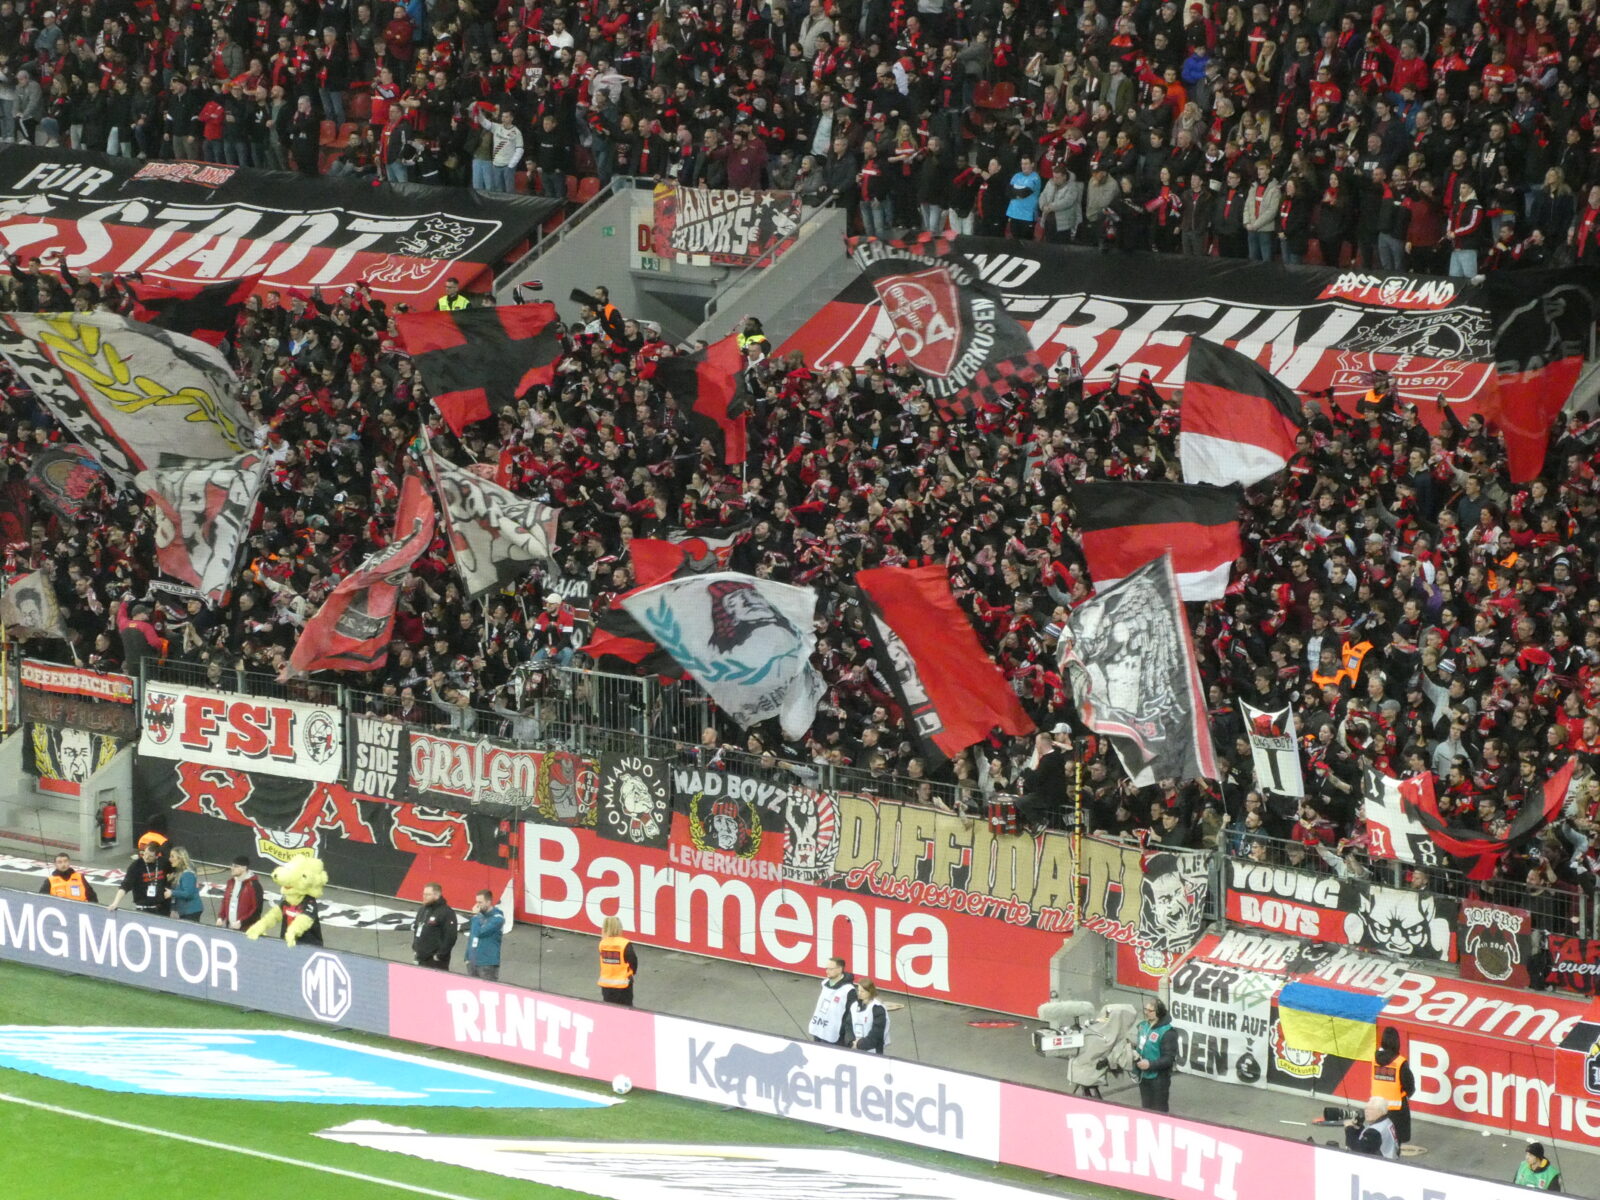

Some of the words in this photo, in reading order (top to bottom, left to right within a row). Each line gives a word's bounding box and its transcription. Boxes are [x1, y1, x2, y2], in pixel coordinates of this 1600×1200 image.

[12, 161, 114, 196] FÜR
[62, 200, 417, 285] STADT
[1426, 314, 1463, 326] 1904
[936, 298, 996, 399] LEVERKUSEN
[179, 694, 296, 762] FSI
[357, 718, 403, 747] WEST
[356, 744, 400, 775] SIDE
[353, 768, 398, 799] BOYZ
[602, 756, 654, 835] COMMANDO
[651, 779, 667, 824] 1989
[673, 770, 722, 797] MAD
[727, 774, 788, 813] BOYZ
[668, 842, 783, 883] LEVERKUSEN
[834, 795, 1143, 932] DIFFIDATI
[1232, 861, 1340, 910] YOUNG
[524, 822, 950, 992] Barmenia
[845, 860, 1031, 926] Ausgesperrte
[1240, 895, 1321, 937] BOYS
[1464, 907, 1523, 934] JOKERS
[0, 903, 68, 957] MG
[80, 918, 239, 992] MOTOR
[1208, 930, 1300, 971] NORD
[306, 957, 348, 1017] MG
[1172, 962, 1239, 1005] DER
[446, 989, 594, 1069] RINTI
[1172, 1000, 1204, 1026] GEHT
[1208, 1010, 1237, 1032] MIR
[1241, 1015, 1268, 1039] AUF
[1175, 1028, 1230, 1077] DEN
[1279, 1061, 1317, 1075] Leverkusen
[1066, 1113, 1243, 1200] RINTI
